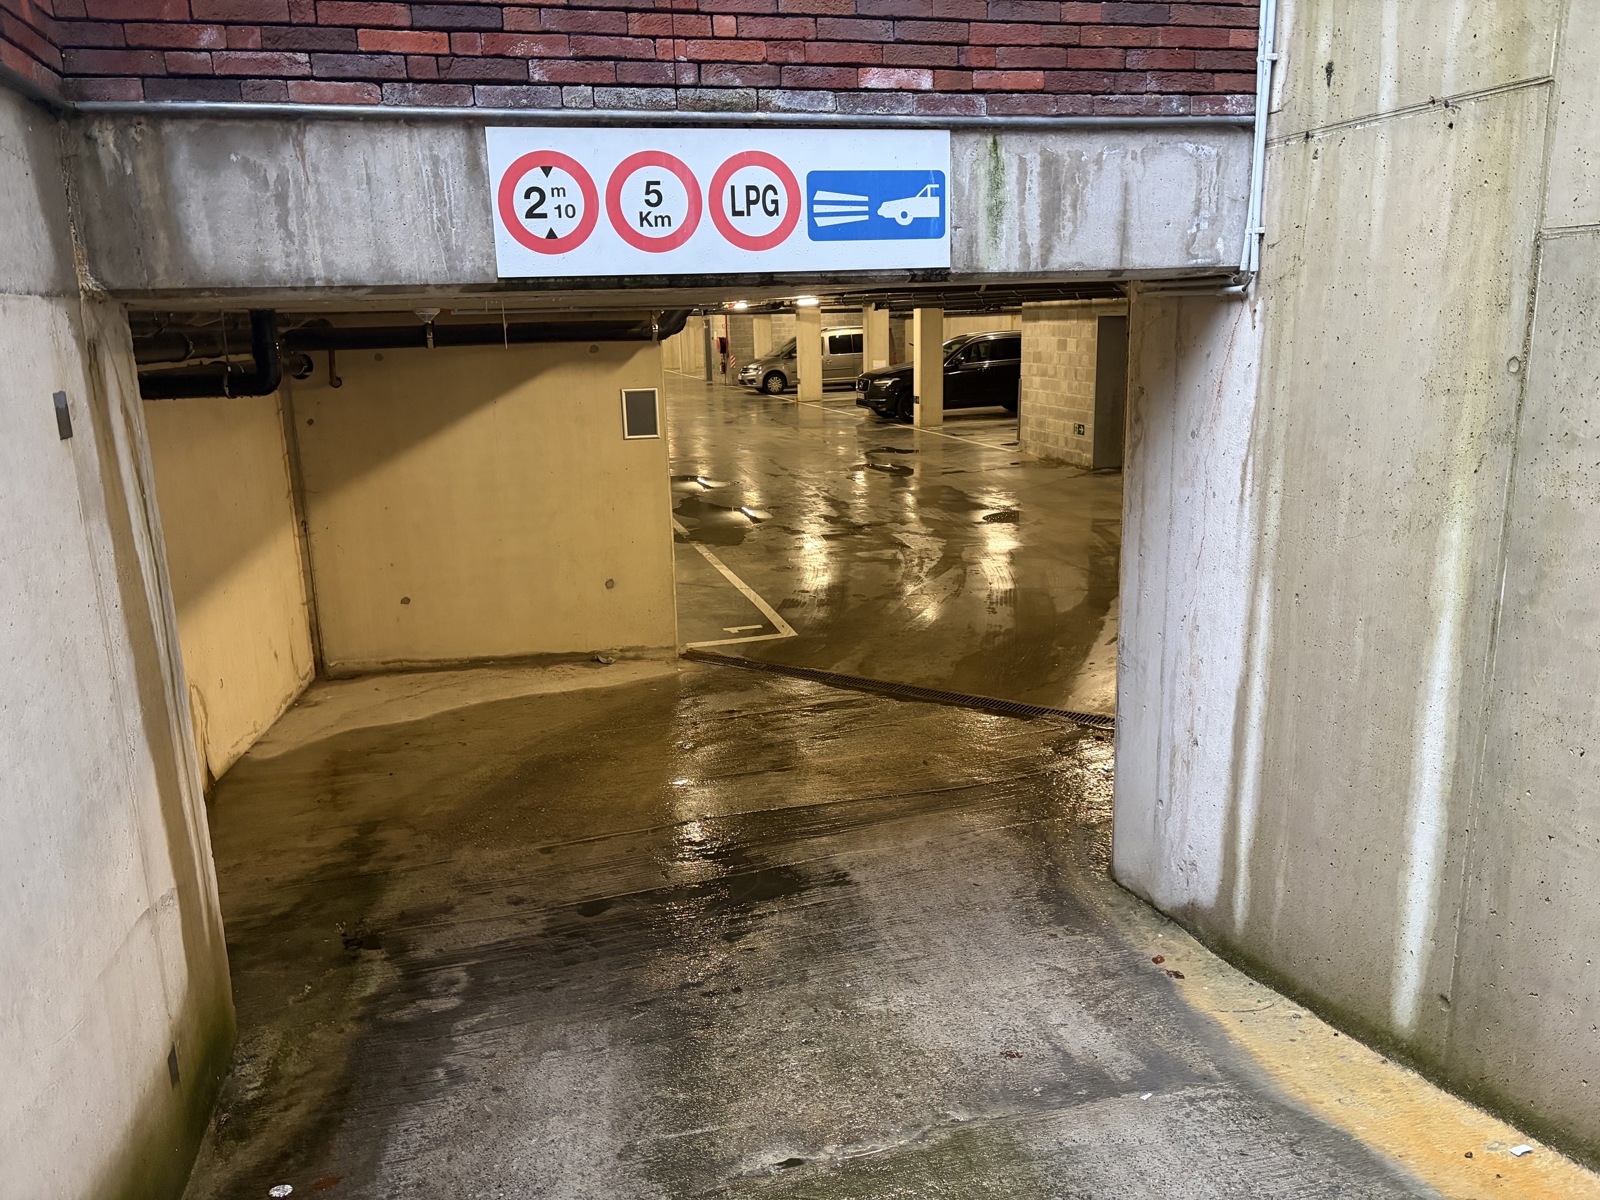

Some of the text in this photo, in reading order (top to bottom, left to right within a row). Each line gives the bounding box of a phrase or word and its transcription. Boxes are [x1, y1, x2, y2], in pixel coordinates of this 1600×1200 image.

[524, 186, 576, 219] 2 m 10
[644, 180, 663, 207] 5
[730, 184, 780, 217] LPG
[639, 211, 672, 227] Km
